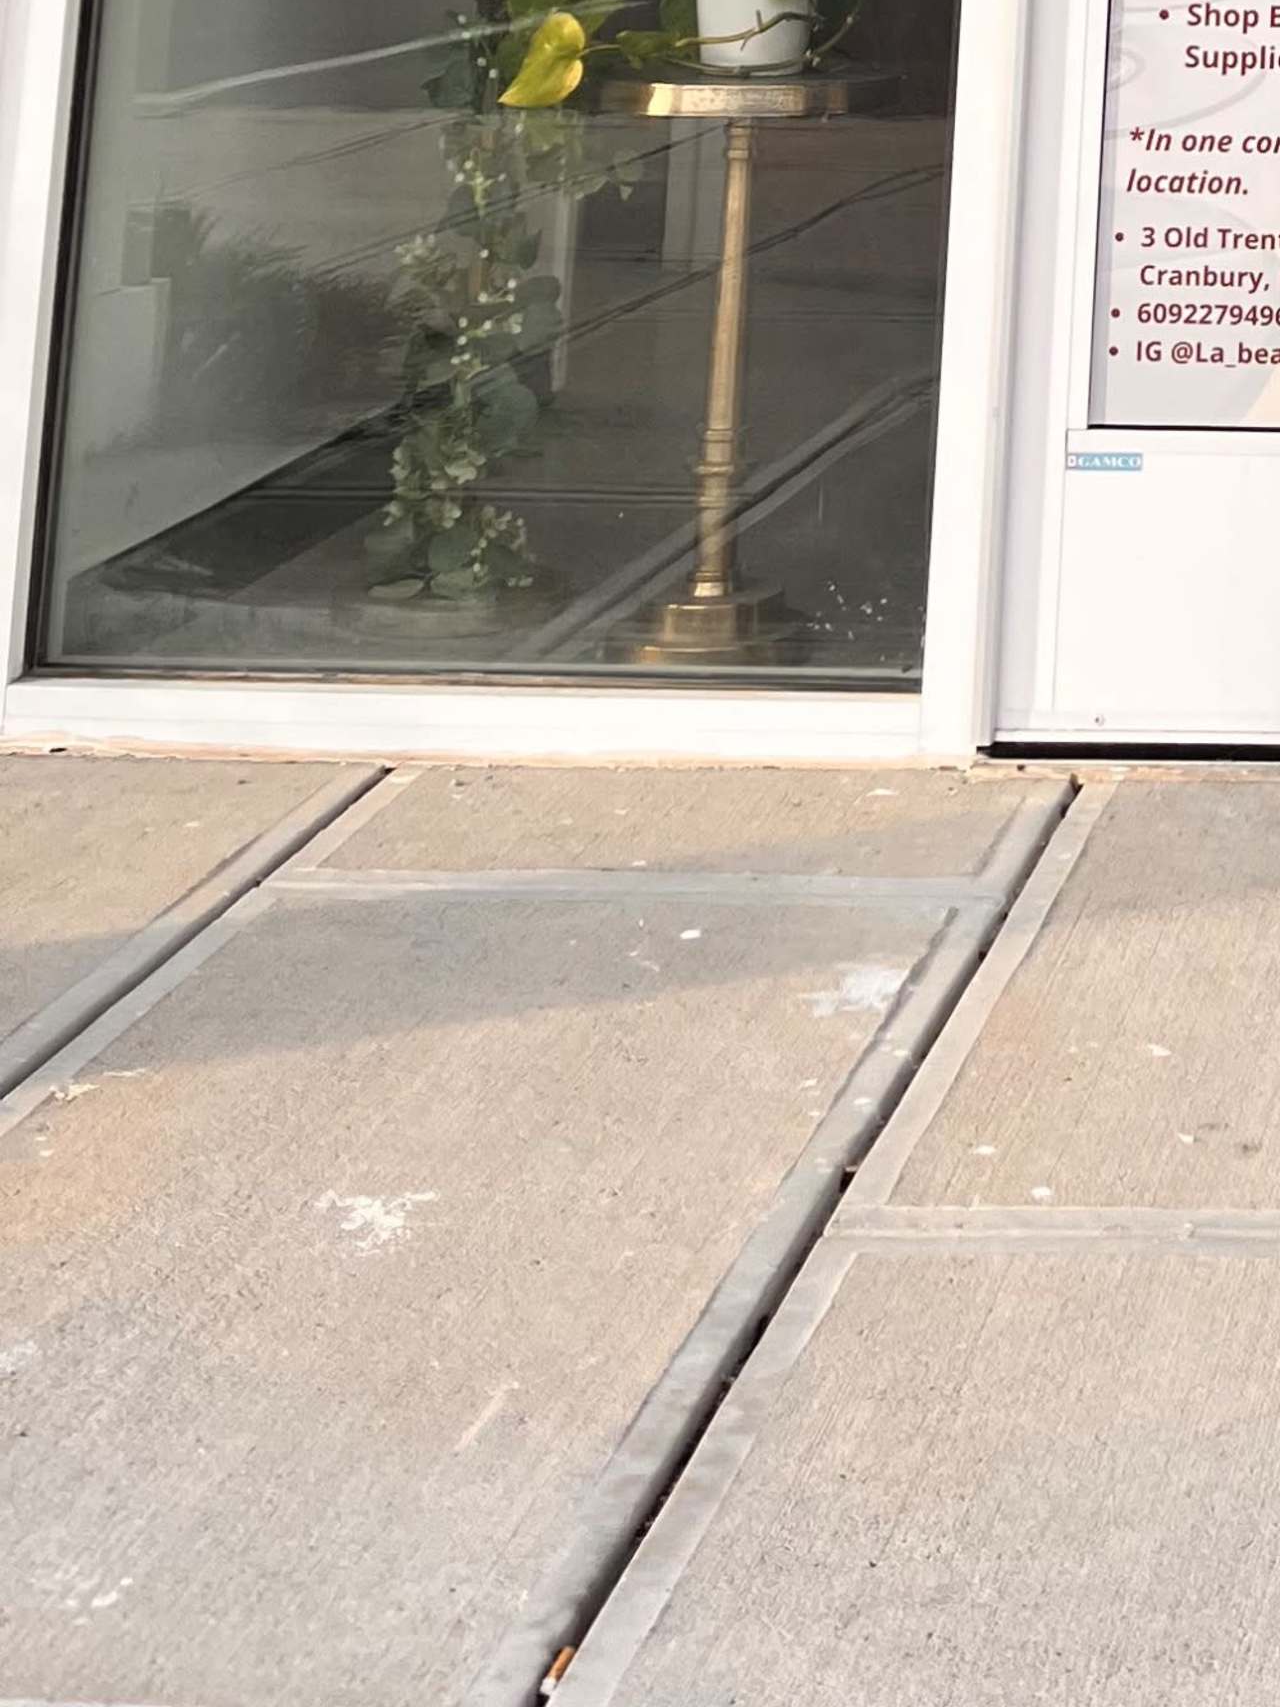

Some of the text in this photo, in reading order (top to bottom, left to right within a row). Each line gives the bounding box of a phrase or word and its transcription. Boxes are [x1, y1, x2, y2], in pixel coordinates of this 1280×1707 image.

[1187, 3, 1259, 33] Shop
[1181, 134, 1232, 153] one
[1126, 169, 1249, 195] location.
[1141, 228, 1156, 248] 3
[1164, 227, 1209, 249] Old
[1140, 265, 1270, 293] Cranbury,
[1136, 341, 1162, 363] IG
